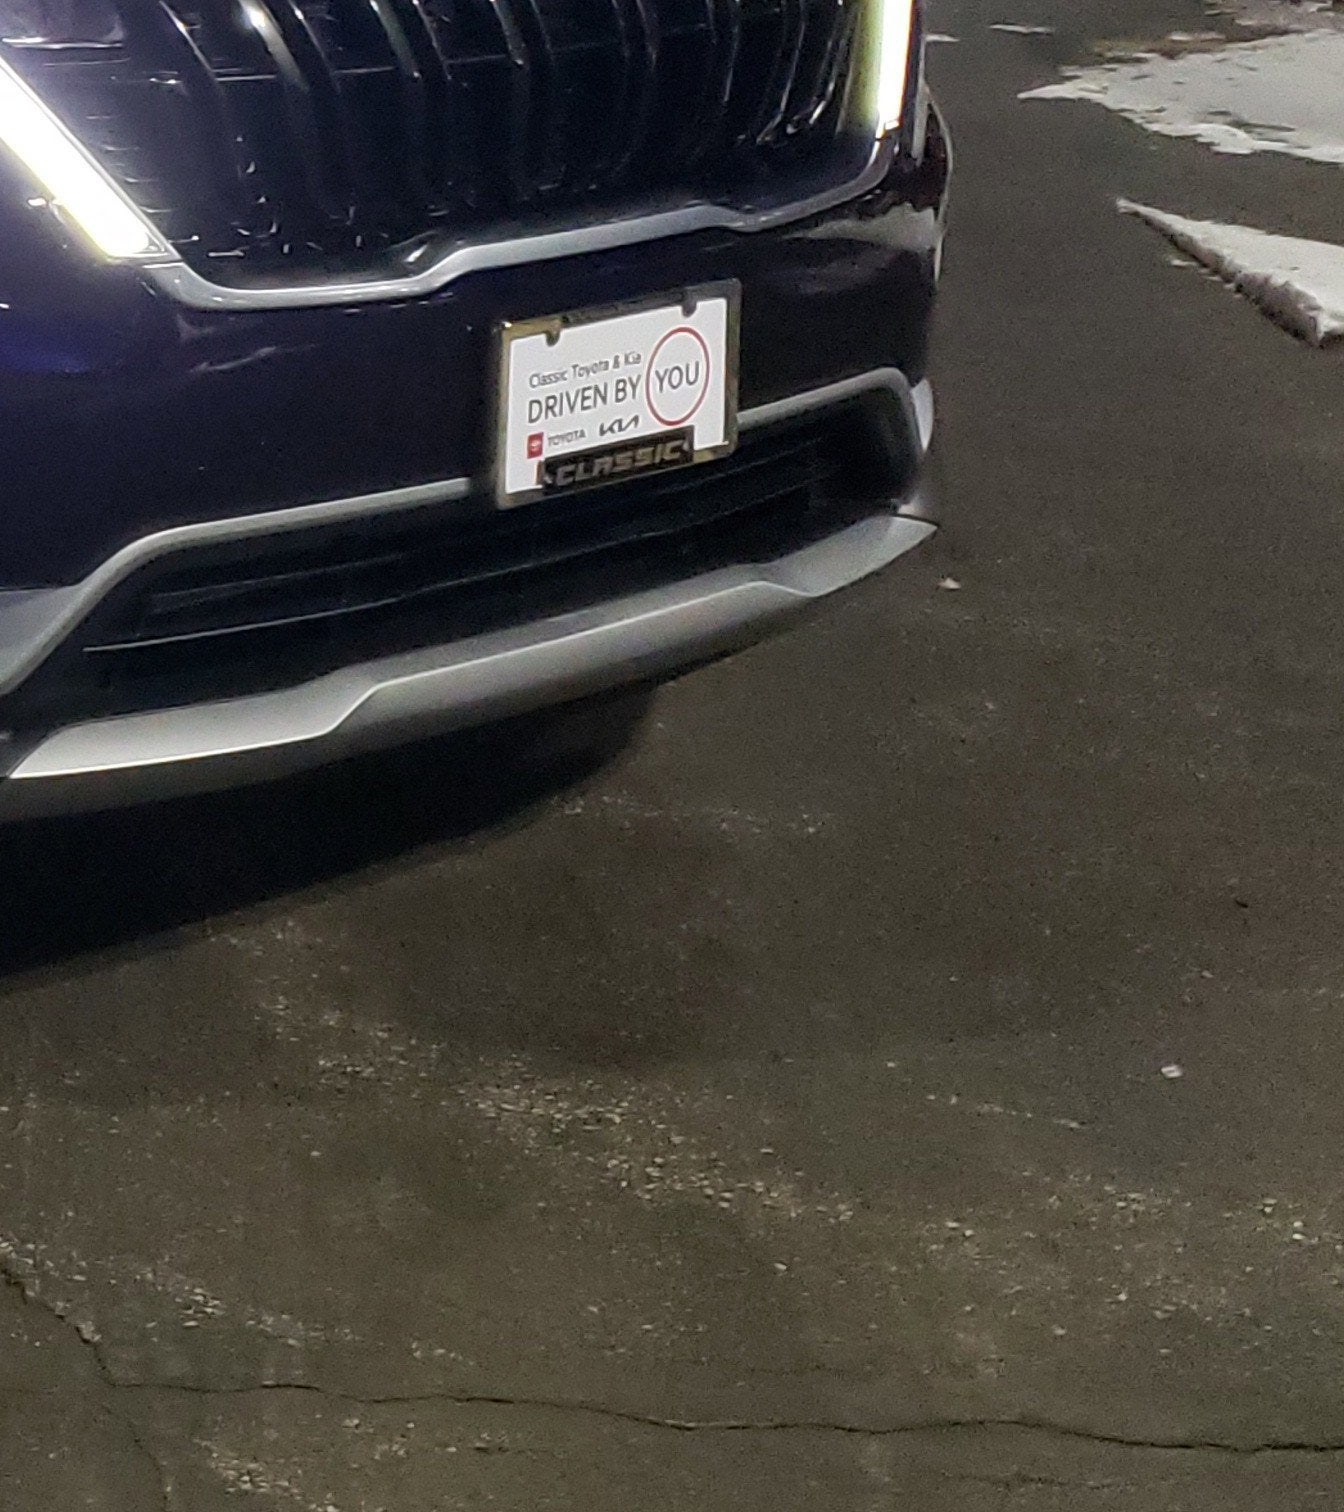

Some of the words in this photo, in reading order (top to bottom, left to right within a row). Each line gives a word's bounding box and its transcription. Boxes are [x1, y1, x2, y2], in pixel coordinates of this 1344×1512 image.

[529, 367, 568, 389] Classic
[572, 359, 610, 380] Toyota
[612, 354, 621, 370] &
[623, 351, 642, 367] Kia
[528, 382, 608, 424] DRIVEN
[614, 374, 642, 404] BY
[654, 361, 700, 394] YOU
[547, 429, 586, 448] TOYOTA
[555, 440, 685, 486] CLASSIC
